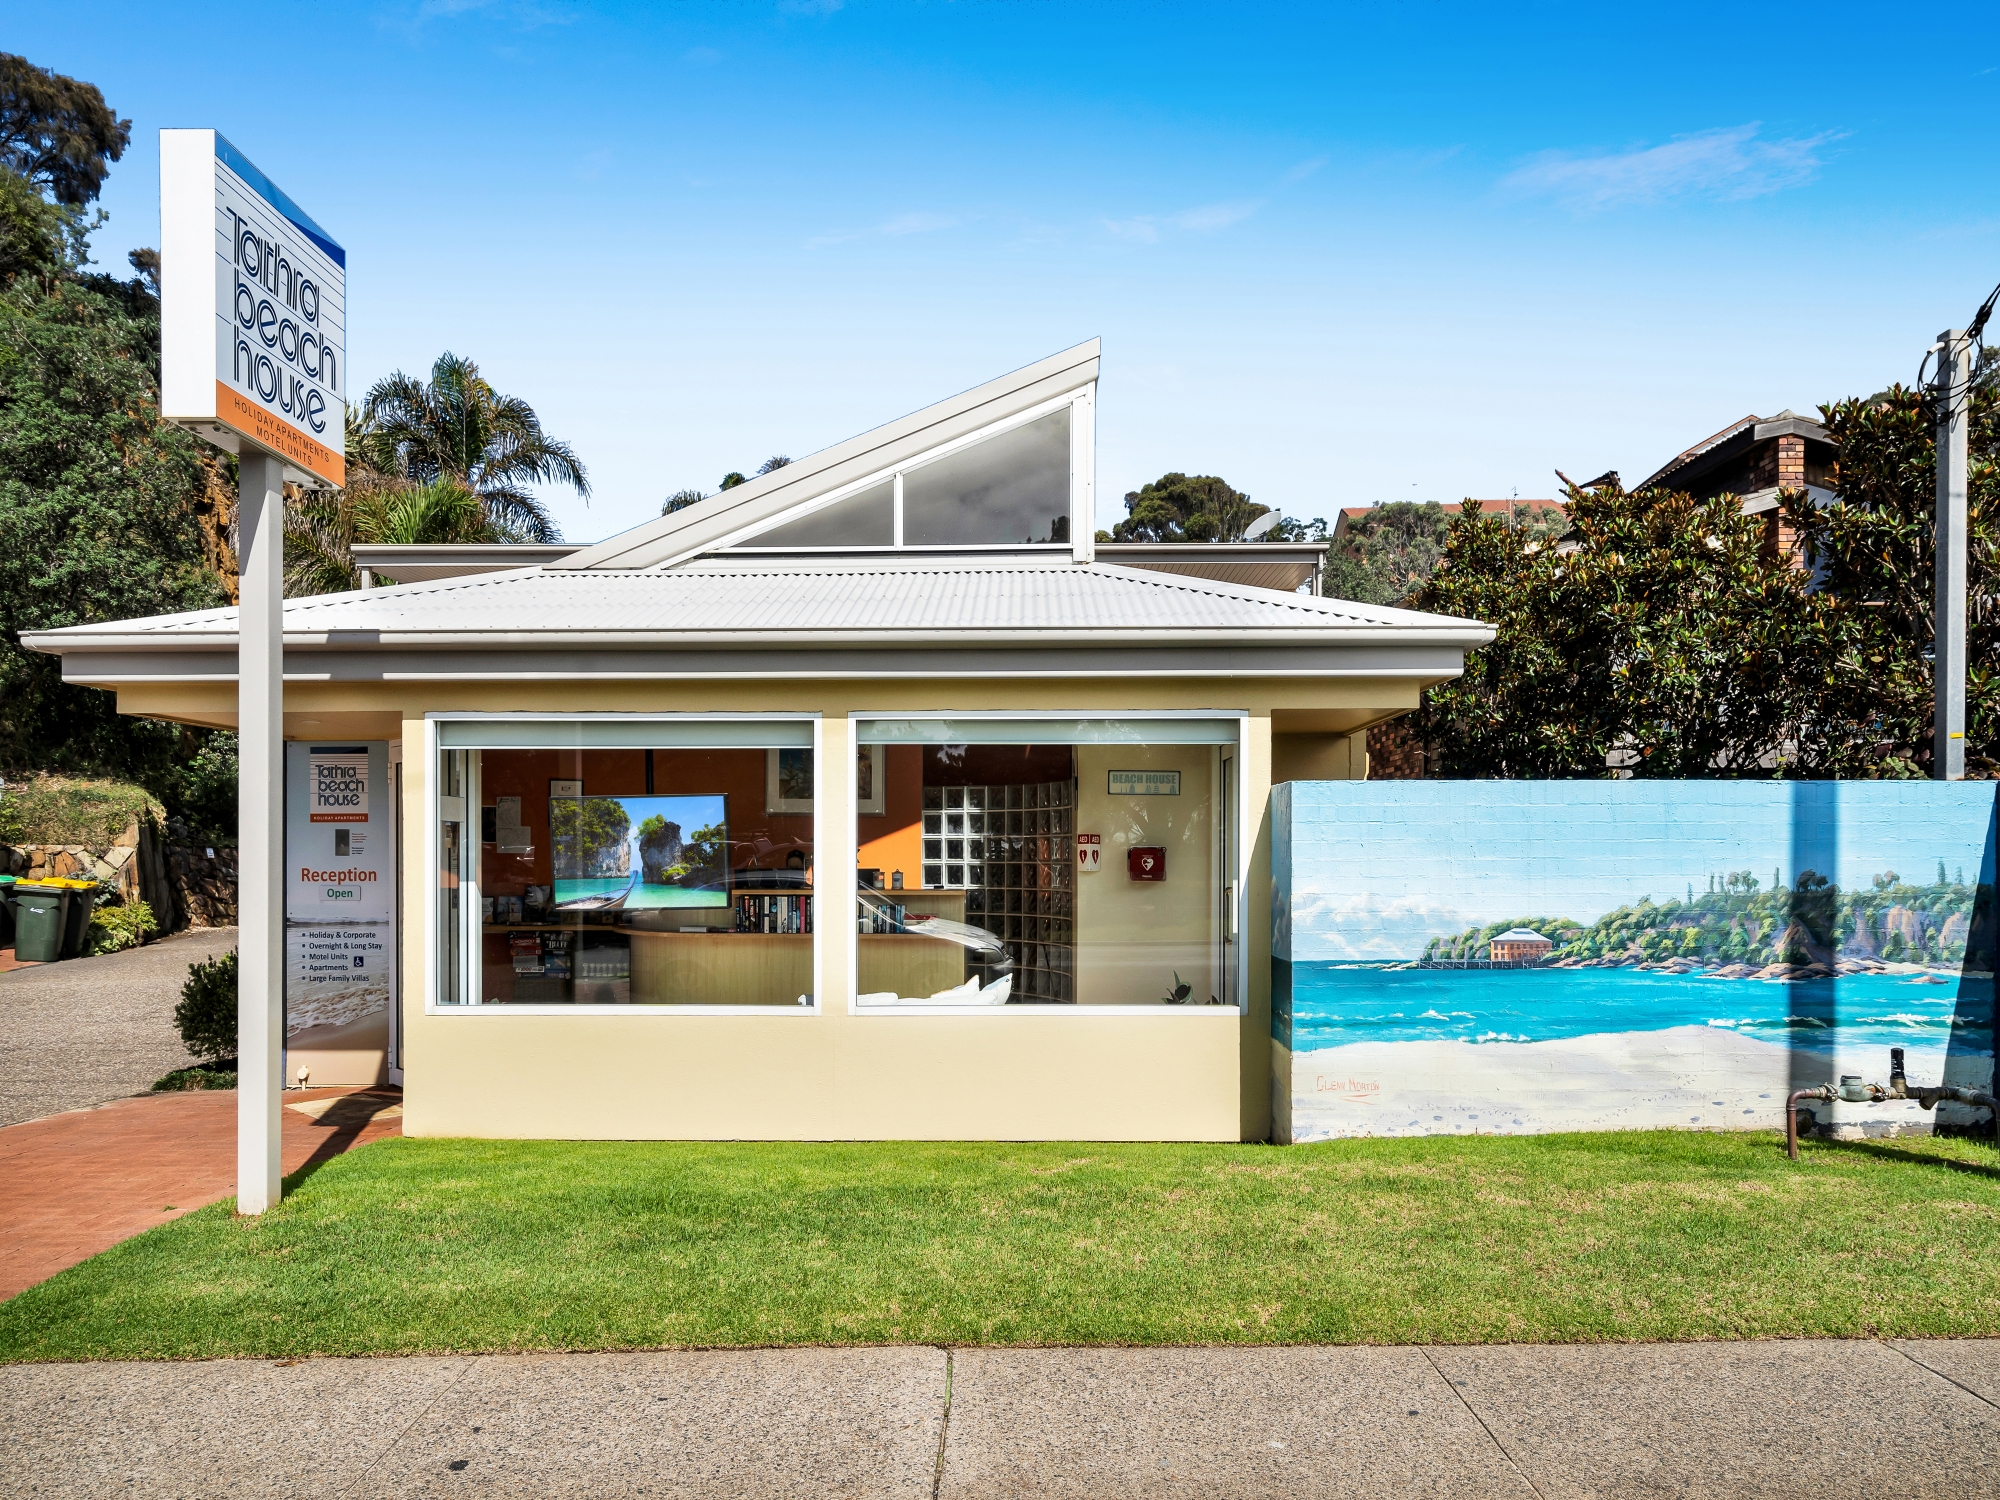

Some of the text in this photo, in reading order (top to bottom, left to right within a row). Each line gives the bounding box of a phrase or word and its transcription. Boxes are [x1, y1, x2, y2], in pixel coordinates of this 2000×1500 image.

[225, 206, 320, 328] Tathra
[234, 267, 337, 391] beach
[234, 324, 326, 434] house
[234, 397, 330, 463] HOLIDAY APARTMENTS
[256, 425, 313, 466] MOTEL UNITS
[315, 764, 357, 778] Tathra
[318, 778, 364, 792] beach
[1112, 773, 1177, 784] BEACH HOUSE
[318, 792, 360, 806] house
[1079, 835, 1088, 843] AED
[301, 867, 377, 885] Reception
[327, 888, 353, 900] Open
[309, 931, 376, 940] Holiday & Corporate
[309, 942, 383, 951] Overnight & Long Stay
[309, 964, 349, 972] Apartments
[309, 974, 370, 983] Large Family Villas
